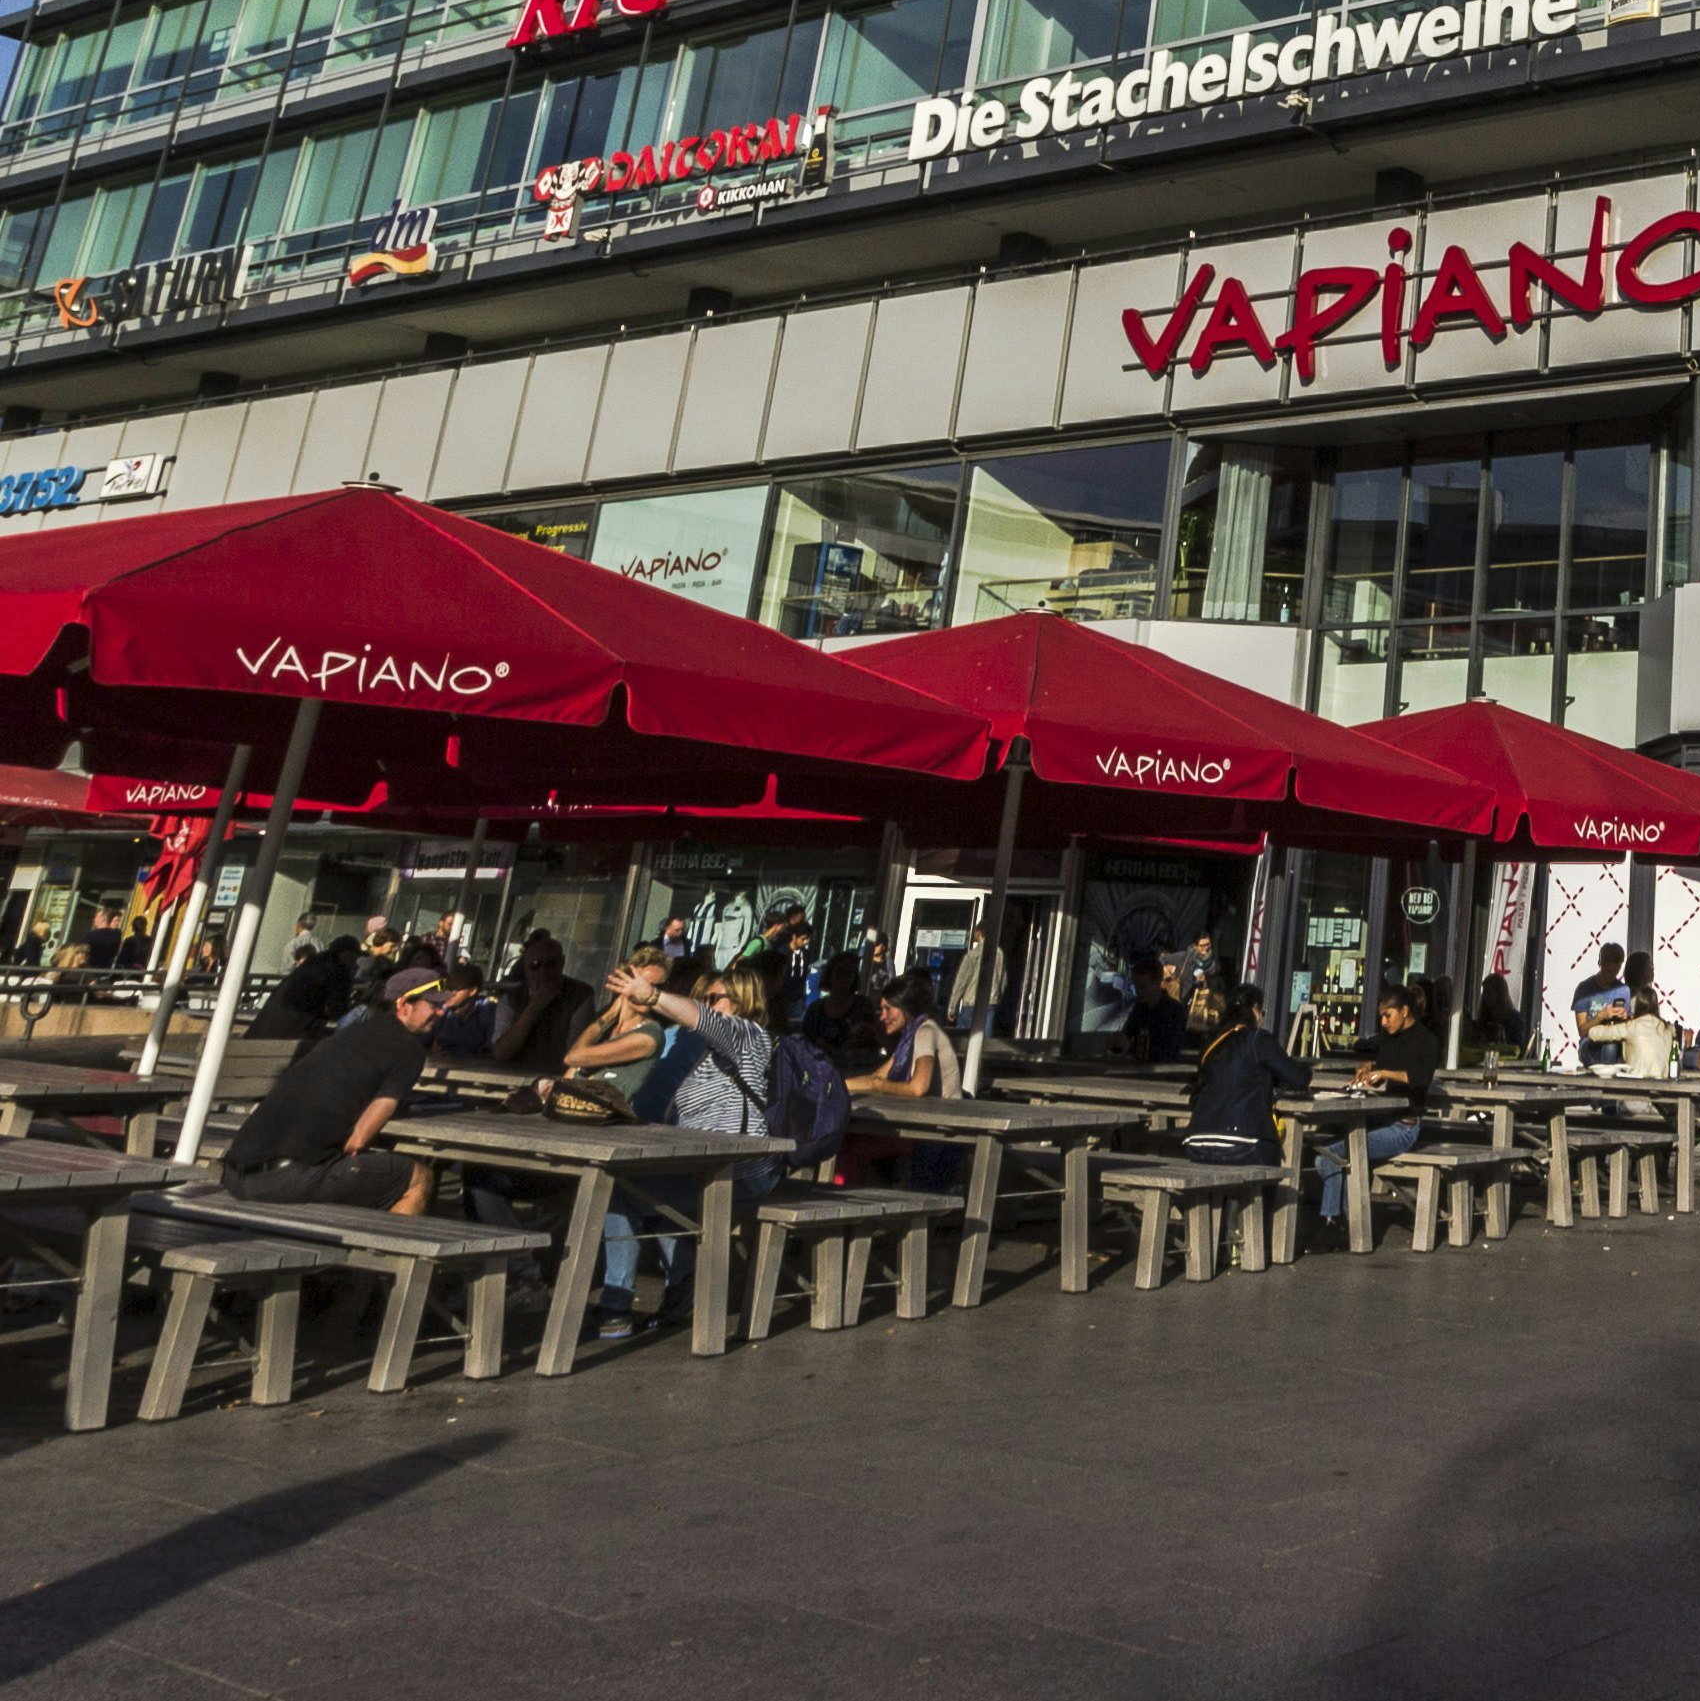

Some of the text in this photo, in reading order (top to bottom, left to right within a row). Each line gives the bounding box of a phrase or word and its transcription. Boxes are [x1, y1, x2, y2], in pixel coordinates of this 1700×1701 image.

[605, 113, 801, 192] DAITOKAI
[908, 97, 1006, 163] Die
[717, 179, 786, 205] KIKKOMAN
[370, 200, 437, 254] dm
[535, 522, 588, 537] Progressiv
